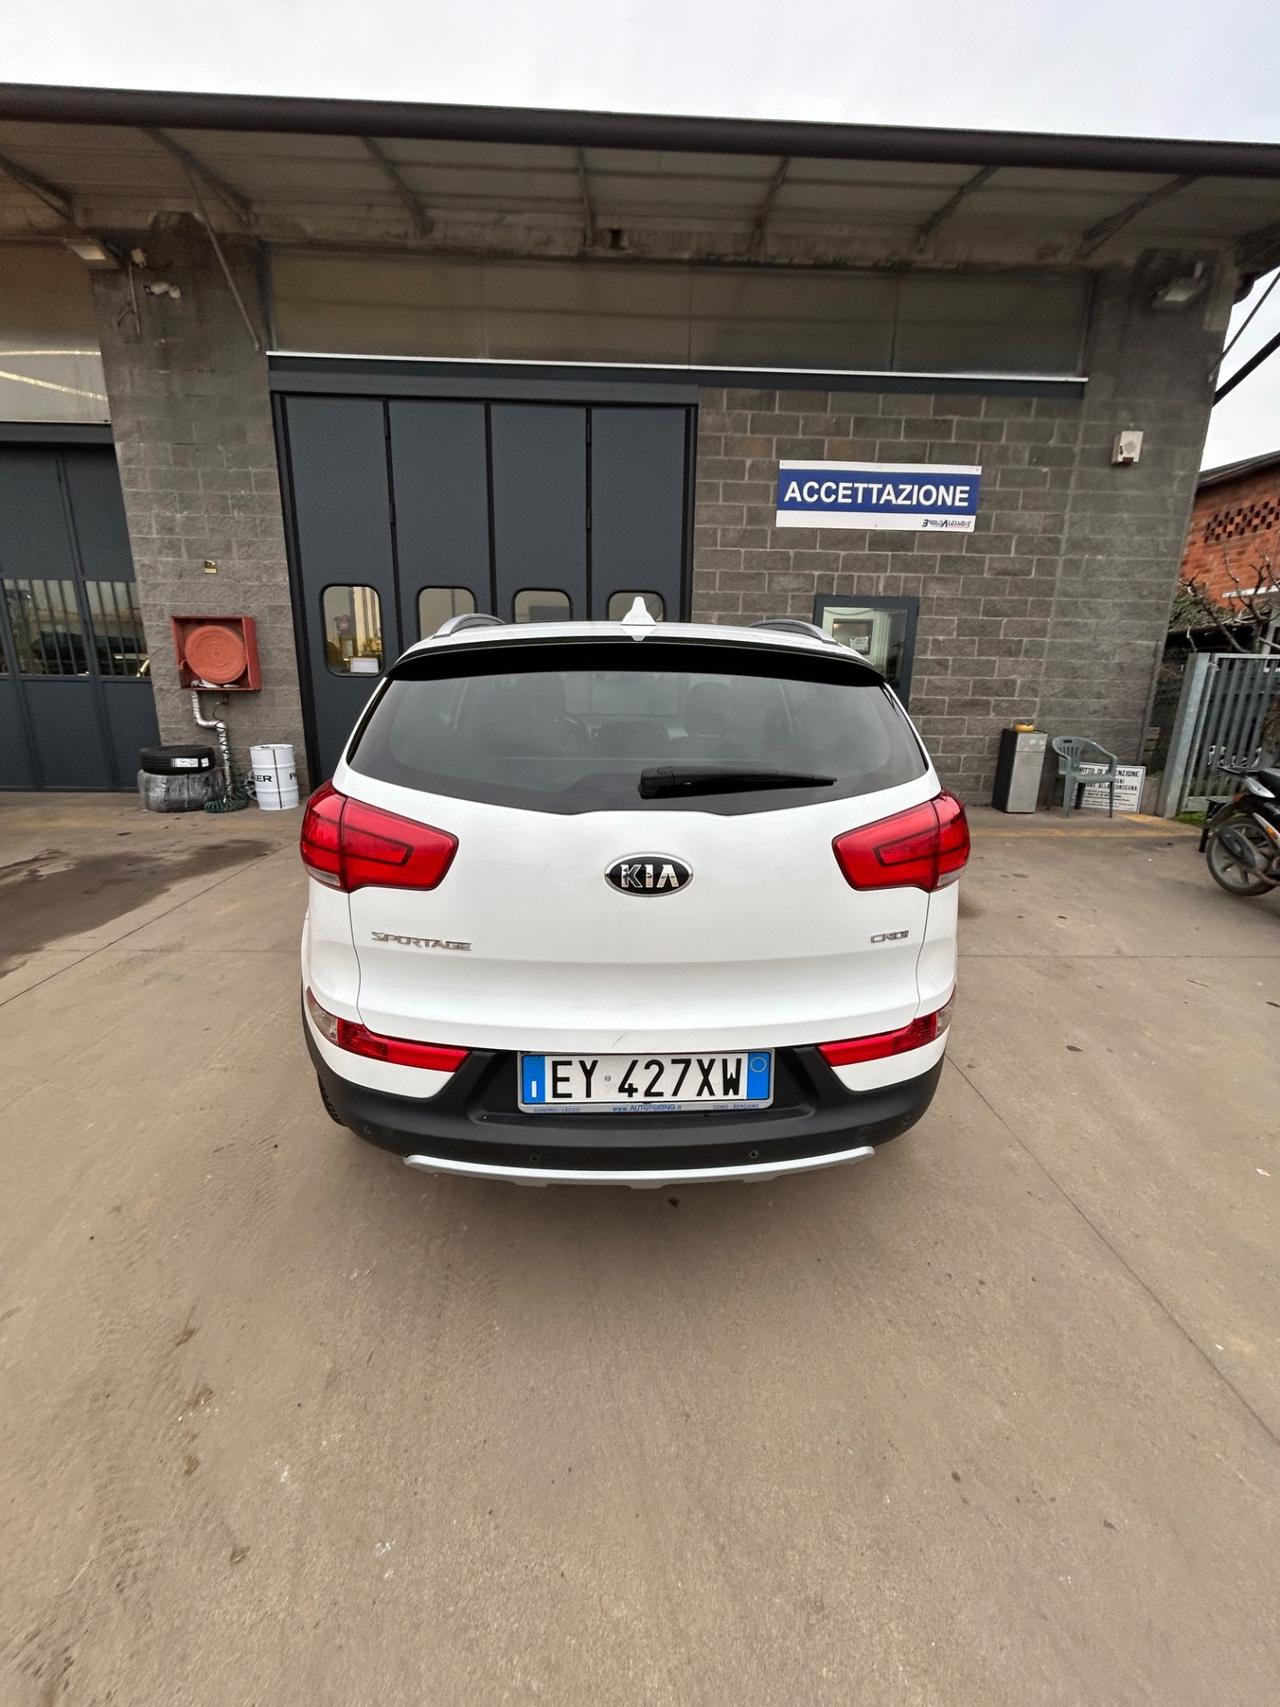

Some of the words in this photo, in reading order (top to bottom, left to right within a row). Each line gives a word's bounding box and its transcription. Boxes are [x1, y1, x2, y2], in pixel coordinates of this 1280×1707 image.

[784, 481, 970, 507] ACCETTAZIONE
[620, 864, 679, 888] KIA
[371, 932, 472, 951] SPORTAGE
[551, 1060, 599, 1099] EY
[617, 1058, 742, 1098] 427XW
